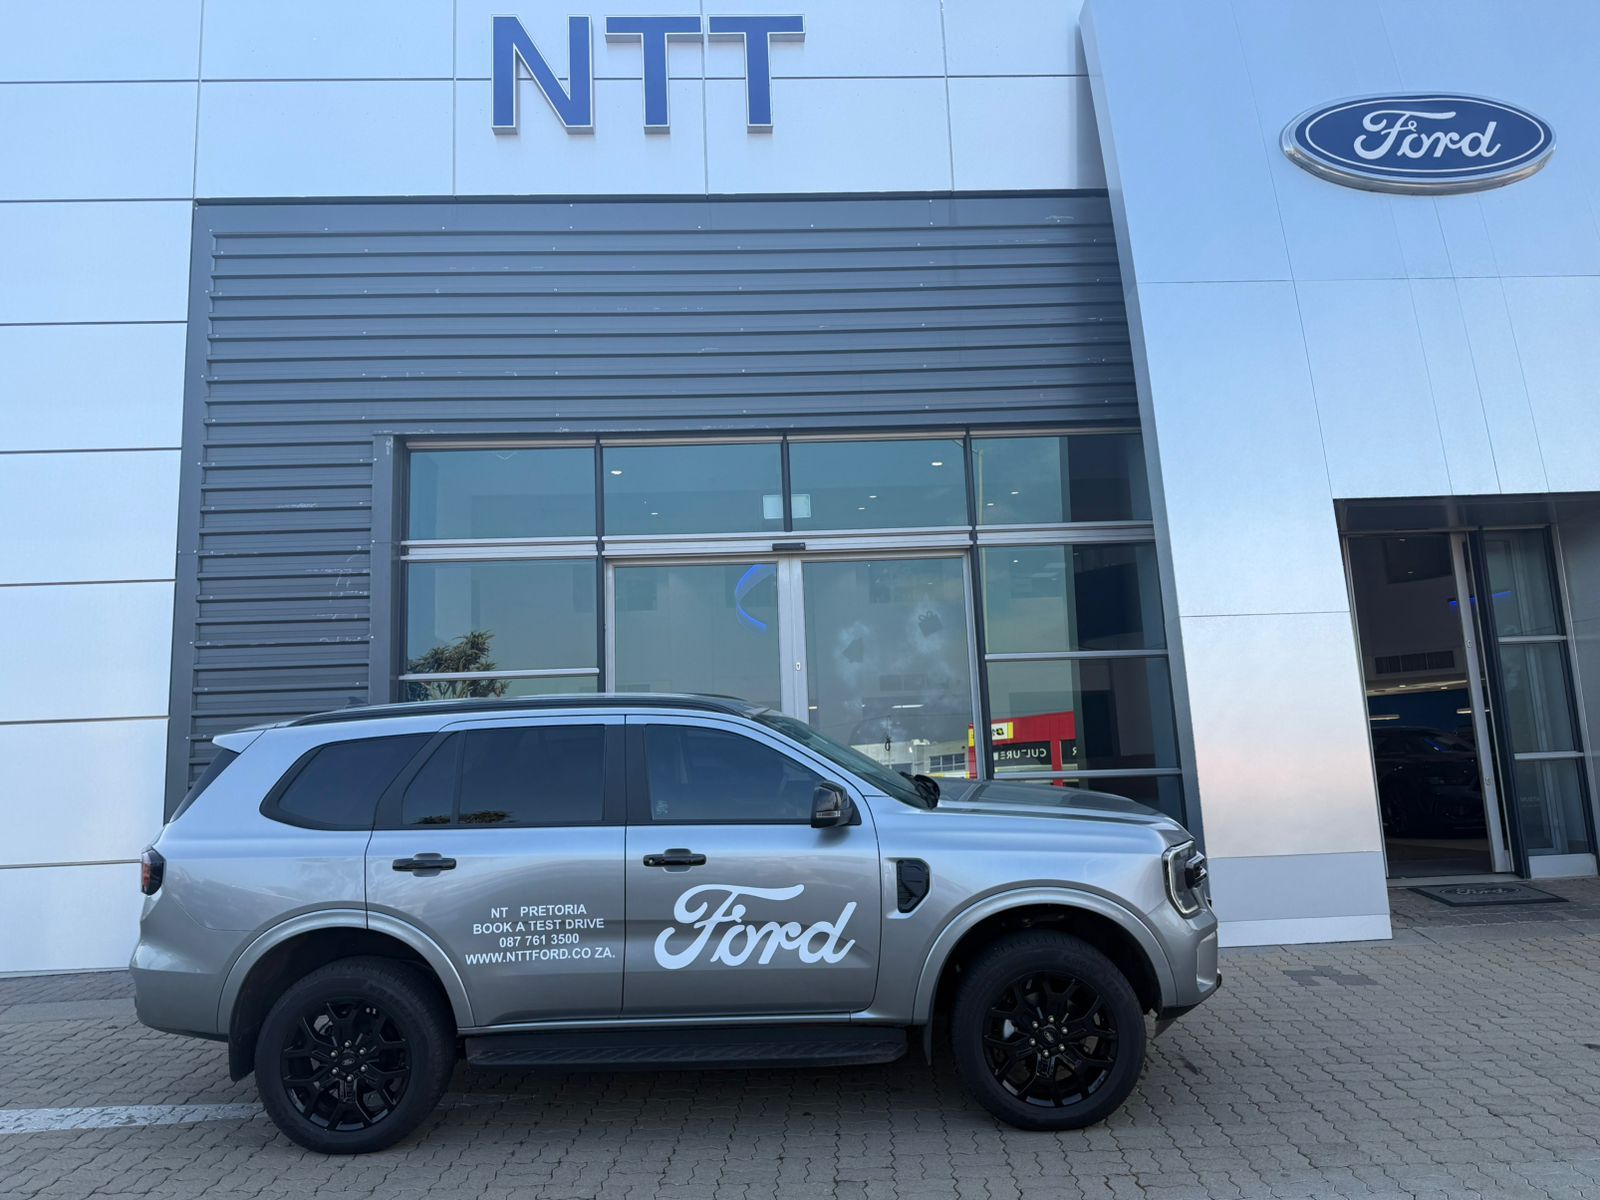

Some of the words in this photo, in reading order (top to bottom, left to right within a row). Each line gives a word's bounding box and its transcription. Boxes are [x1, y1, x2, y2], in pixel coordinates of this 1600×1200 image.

[491, 14, 806, 135] NTT
[1353, 109, 1502, 160] Ford
[472, 921, 513, 935] BOOK
[515, 921, 526, 932] A
[528, 919, 562, 932] TEST
[565, 918, 605, 930] DRIVE
[519, 903, 587, 918] PRETORIA
[654, 883, 857, 970] Ford
[499, 936, 521, 948] 087
[525, 934, 546, 947] 761
[550, 933, 580, 945] 3500
